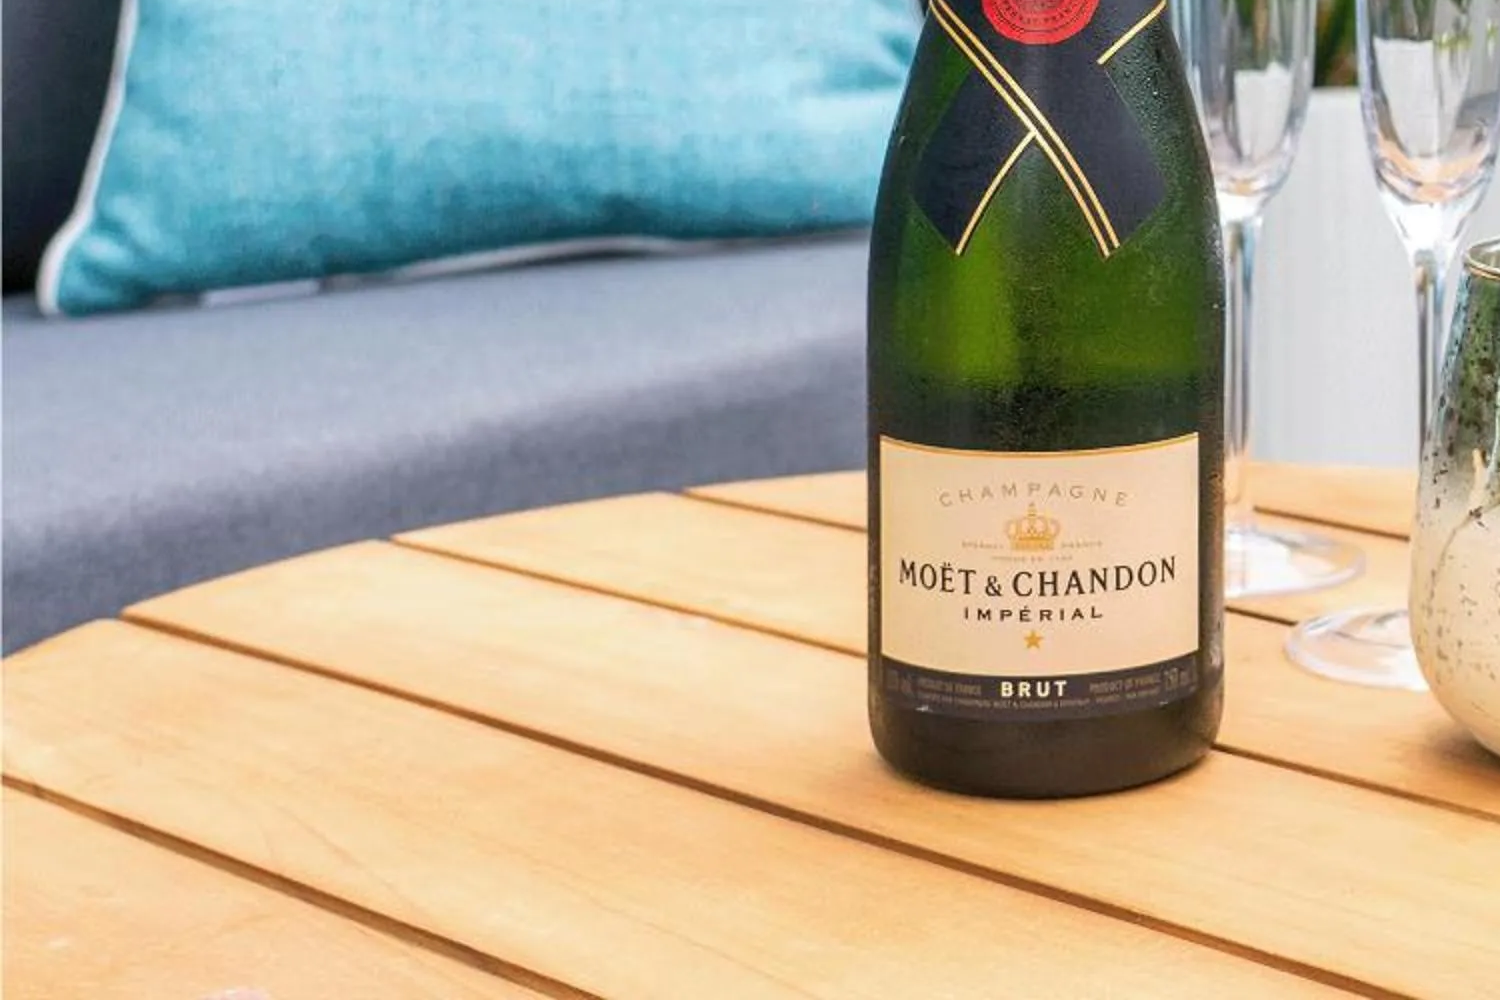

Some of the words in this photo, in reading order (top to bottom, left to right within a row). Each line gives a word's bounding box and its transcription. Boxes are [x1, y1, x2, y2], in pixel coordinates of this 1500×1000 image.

[939, 482, 1129, 507] CHAMPAGNE
[899, 558, 976, 595] MOËT
[984, 575, 1002, 597] &
[1012, 556, 1176, 597] CHANDON
[964, 605, 1104, 623] IMPÉRIAL
[1001, 680, 1067, 698] BRUT
